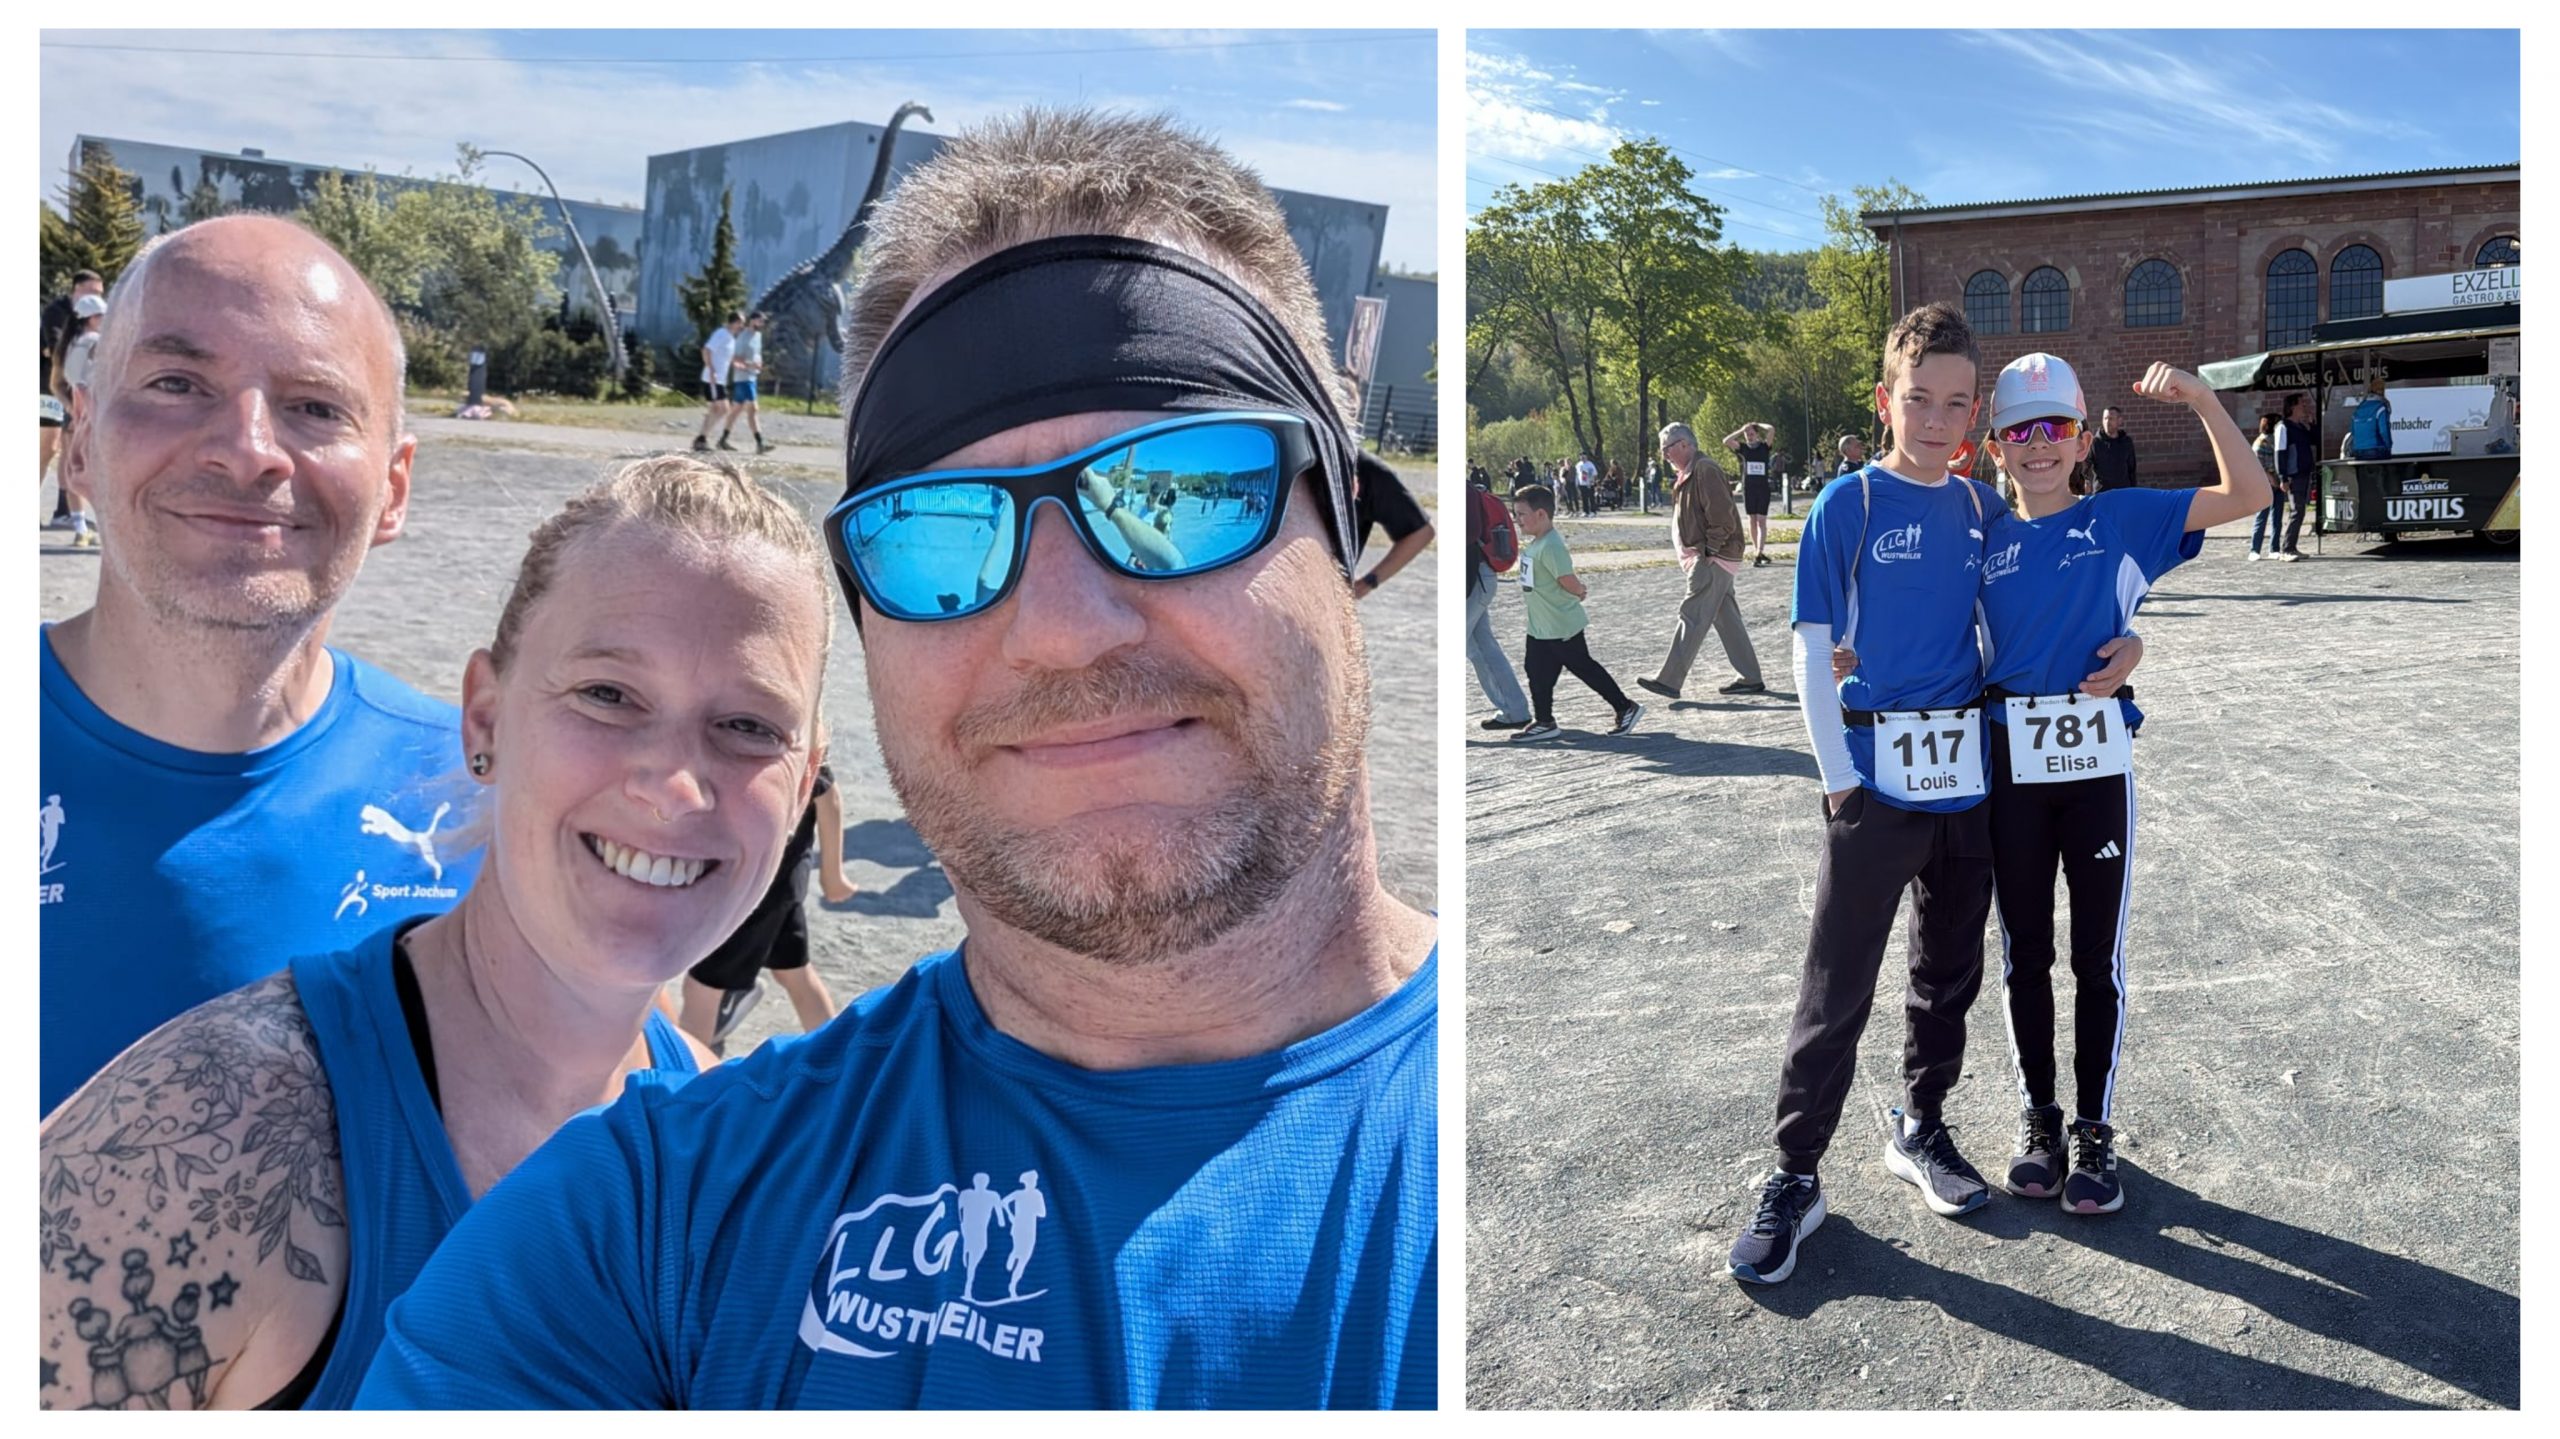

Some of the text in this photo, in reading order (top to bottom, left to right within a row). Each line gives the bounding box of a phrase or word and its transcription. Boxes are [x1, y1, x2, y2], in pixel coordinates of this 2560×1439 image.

[2453, 268, 2520, 294] EXZELL
[2453, 292, 2495, 305] GASTRO
[2496, 291, 2503, 301] &
[2266, 370, 2333, 388] KARLSBEG
[2390, 416, 2433, 431] mbacher
[2402, 482, 2449, 493] KARLSBERG
[2387, 497, 2465, 521] URPILS
[1879, 532, 1906, 552] LLG
[1881, 552, 1922, 560] WUSTWEILER
[1984, 553, 2006, 576] LLG
[2025, 709, 2108, 750] 781
[1893, 729, 1965, 767] 117
[2046, 754, 2098, 773] Elisa
[1906, 771, 1958, 791] Louis
[372, 884, 458, 900] Sport Jochum
[827, 1200, 960, 1297] LLG
